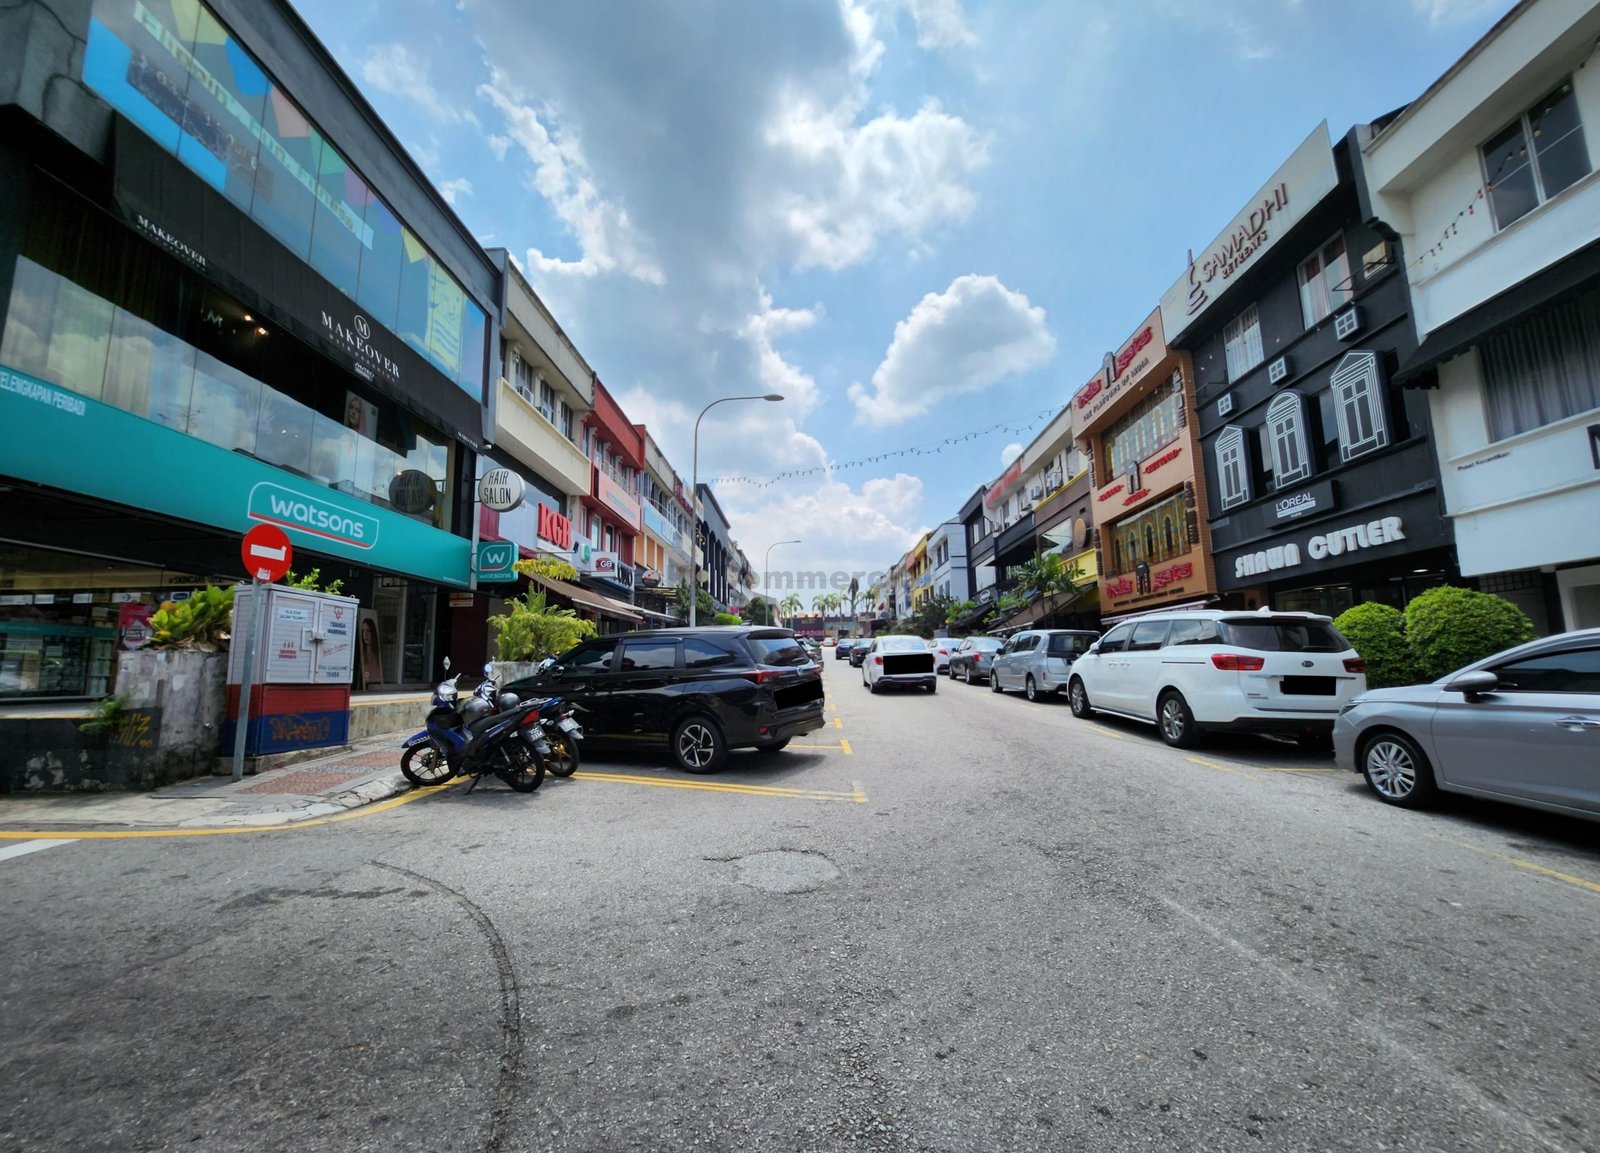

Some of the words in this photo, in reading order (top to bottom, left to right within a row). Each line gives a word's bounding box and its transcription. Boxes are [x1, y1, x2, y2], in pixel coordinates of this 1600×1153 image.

[138, 214, 206, 267] MAKEOVER
[1203, 183, 1288, 283] SAMADHI
[1222, 230, 1268, 280] RETREATS
[321, 310, 399, 378] MAKEOVER
[484, 487, 511, 504] SALON
[488, 470, 509, 485] HAIR
[270, 494, 364, 538] watsons
[538, 503, 573, 550] KGB
[1235, 543, 1301, 578] SHAWN
[1308, 516, 1406, 560] CUTLER
